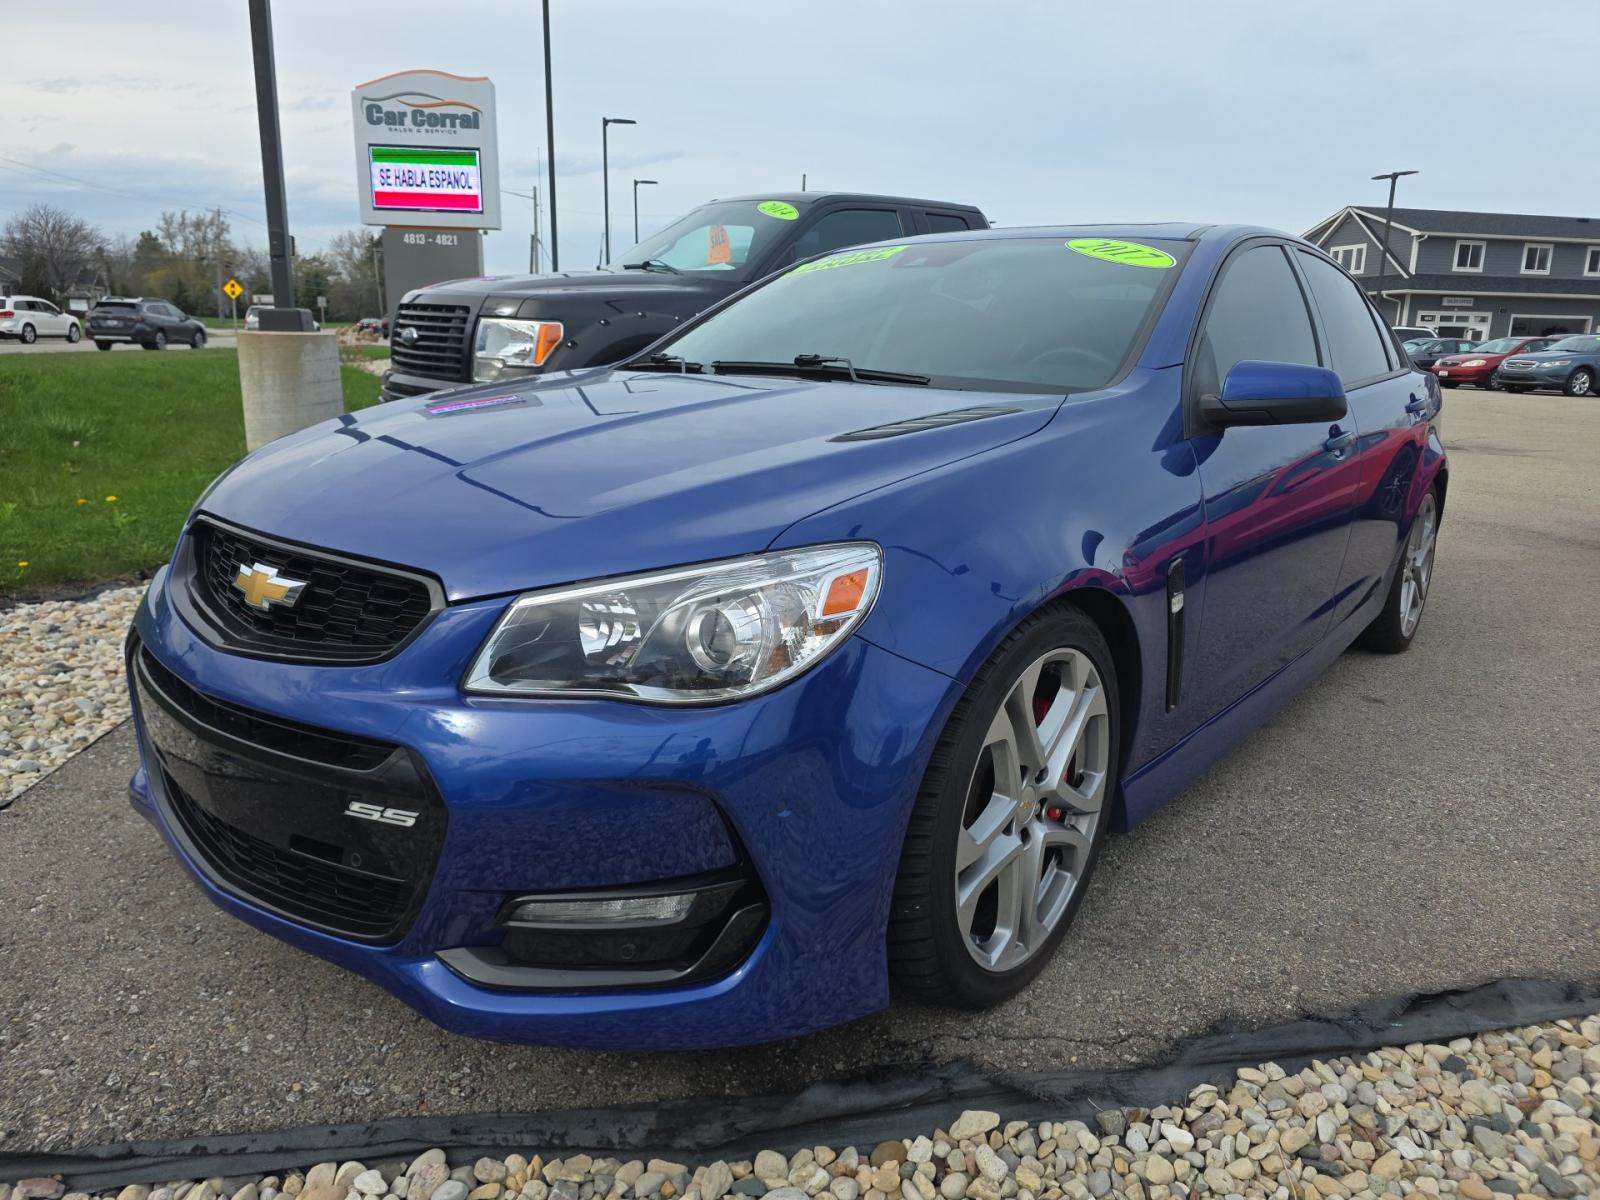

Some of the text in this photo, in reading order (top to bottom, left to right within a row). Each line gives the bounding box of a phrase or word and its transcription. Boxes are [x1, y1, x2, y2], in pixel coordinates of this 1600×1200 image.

[365, 103, 480, 130] Car Corral
[379, 168, 473, 190] SE HABLA ESPANOL
[403, 233, 426, 244] 4813
[435, 234, 458, 246] 4821
[1074, 241, 1165, 261] 2017
[344, 801, 419, 827] SS
